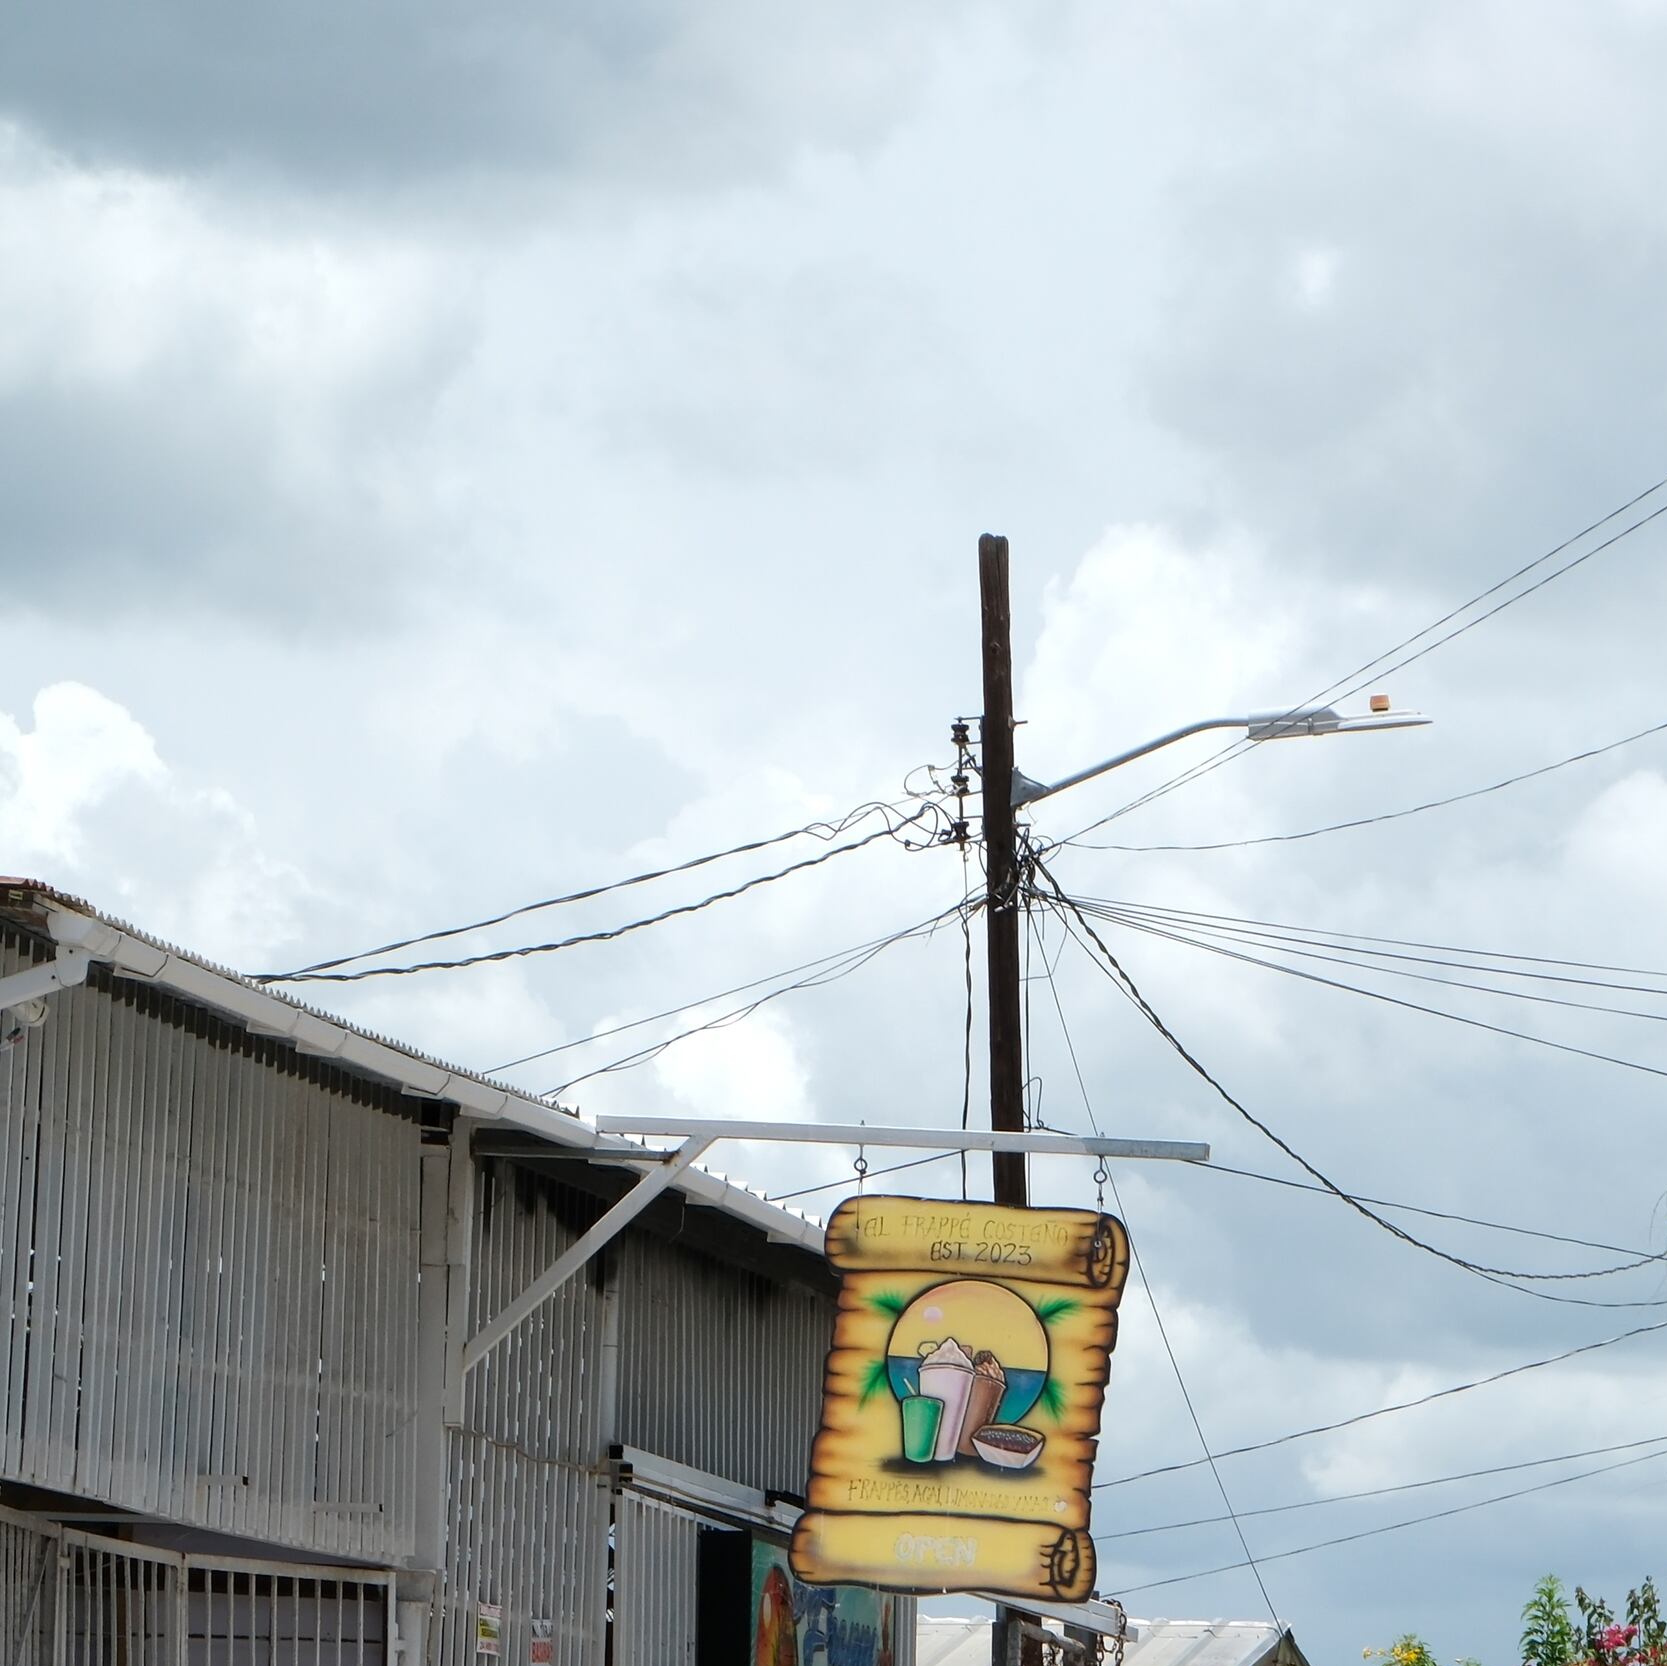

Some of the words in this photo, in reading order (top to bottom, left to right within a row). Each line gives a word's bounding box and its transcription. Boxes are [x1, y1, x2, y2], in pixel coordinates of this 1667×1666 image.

[983, 1219, 1069, 1246] COSTEÑO
[975, 1242, 1032, 1266] 2023
[895, 1531, 977, 1569] OPEN
